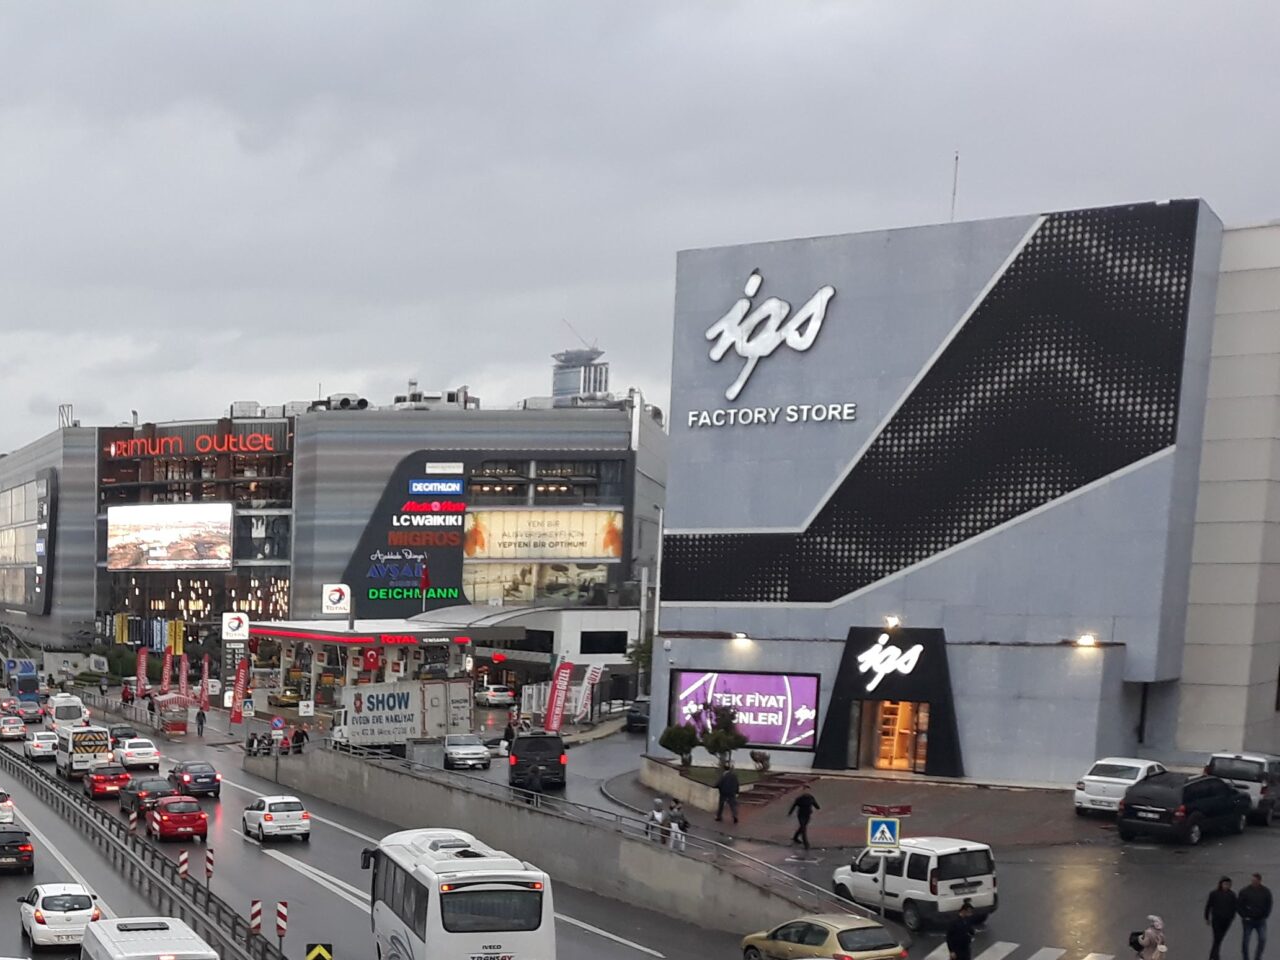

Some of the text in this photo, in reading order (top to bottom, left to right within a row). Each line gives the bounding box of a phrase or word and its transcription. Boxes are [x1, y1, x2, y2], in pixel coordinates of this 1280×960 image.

[688, 403, 857, 428] FACTORY STORE
[195, 433, 273, 453] outlet
[412, 482, 460, 492] DECATHLON
[392, 515, 410, 527] LC
[388, 531, 460, 546] MIGROS
[533, 540, 546, 548] BİR
[368, 588, 459, 599] DEICHMANN
[379, 634, 419, 644] TOTAL
[366, 691, 410, 712] SHOW
[745, 692, 787, 708] FİYAT
